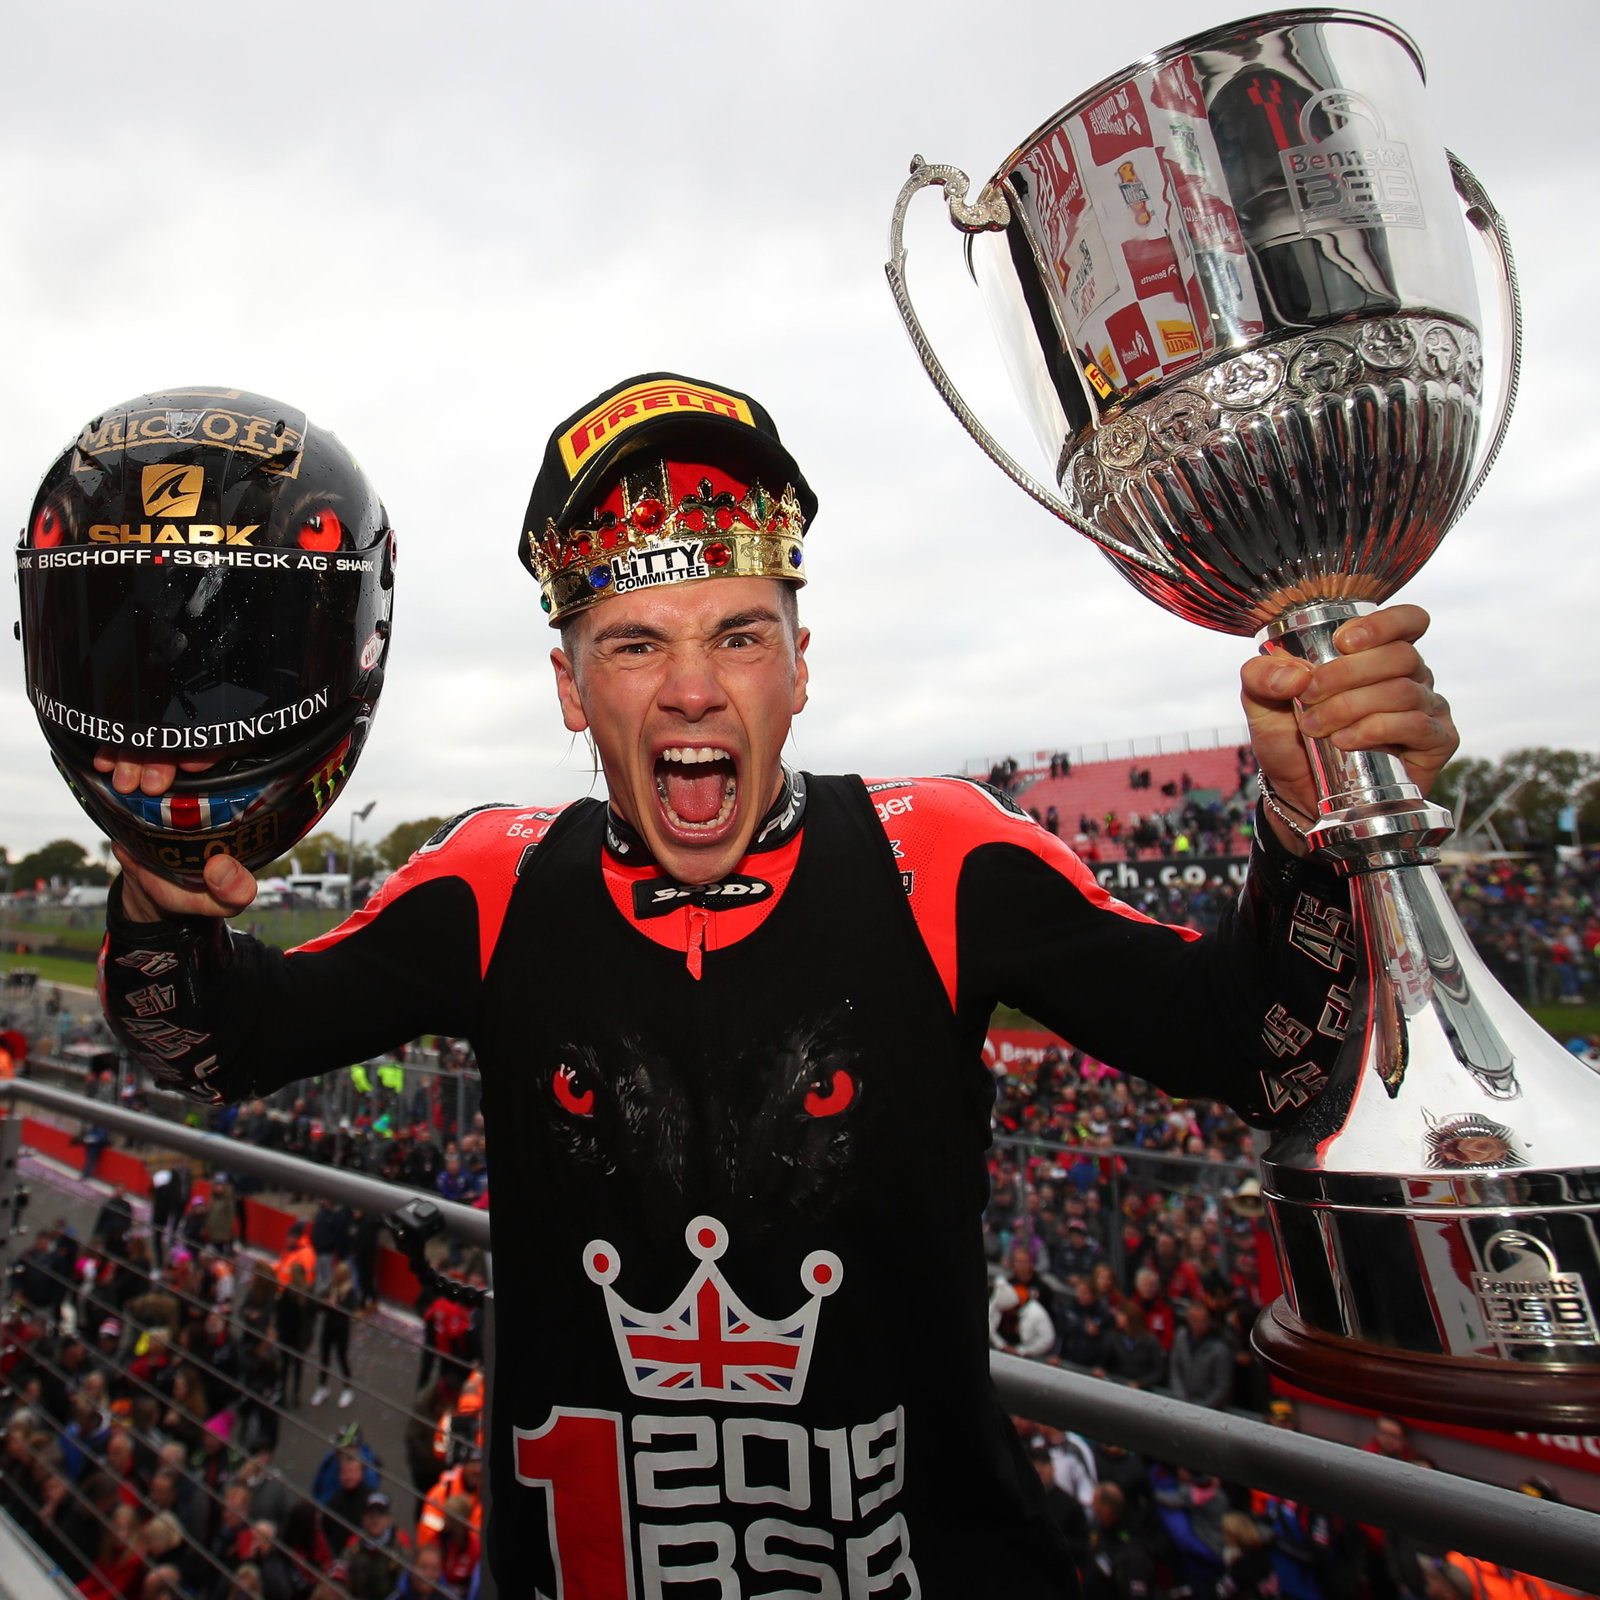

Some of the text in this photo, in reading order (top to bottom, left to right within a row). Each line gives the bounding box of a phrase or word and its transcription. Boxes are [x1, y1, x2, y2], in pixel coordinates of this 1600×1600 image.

[1288, 147, 1406, 174] Bennetts
[570, 386, 740, 460] PIRELLI
[87, 523, 260, 547] SHARK
[38, 548, 152, 569] BISCHOFF
[173, 549, 291, 568] SCHECK
[296, 554, 328, 570] AG
[335, 558, 374, 572] SHARK
[615, 565, 707, 593] COMMITTEE
[33, 684, 331, 750] WATCHES of DISTINCTION
[506, 823, 535, 839] Be
[631, 1404, 906, 1522] 2019
[512, 1405, 638, 1600] 1
[638, 1511, 922, 1600] BSB
